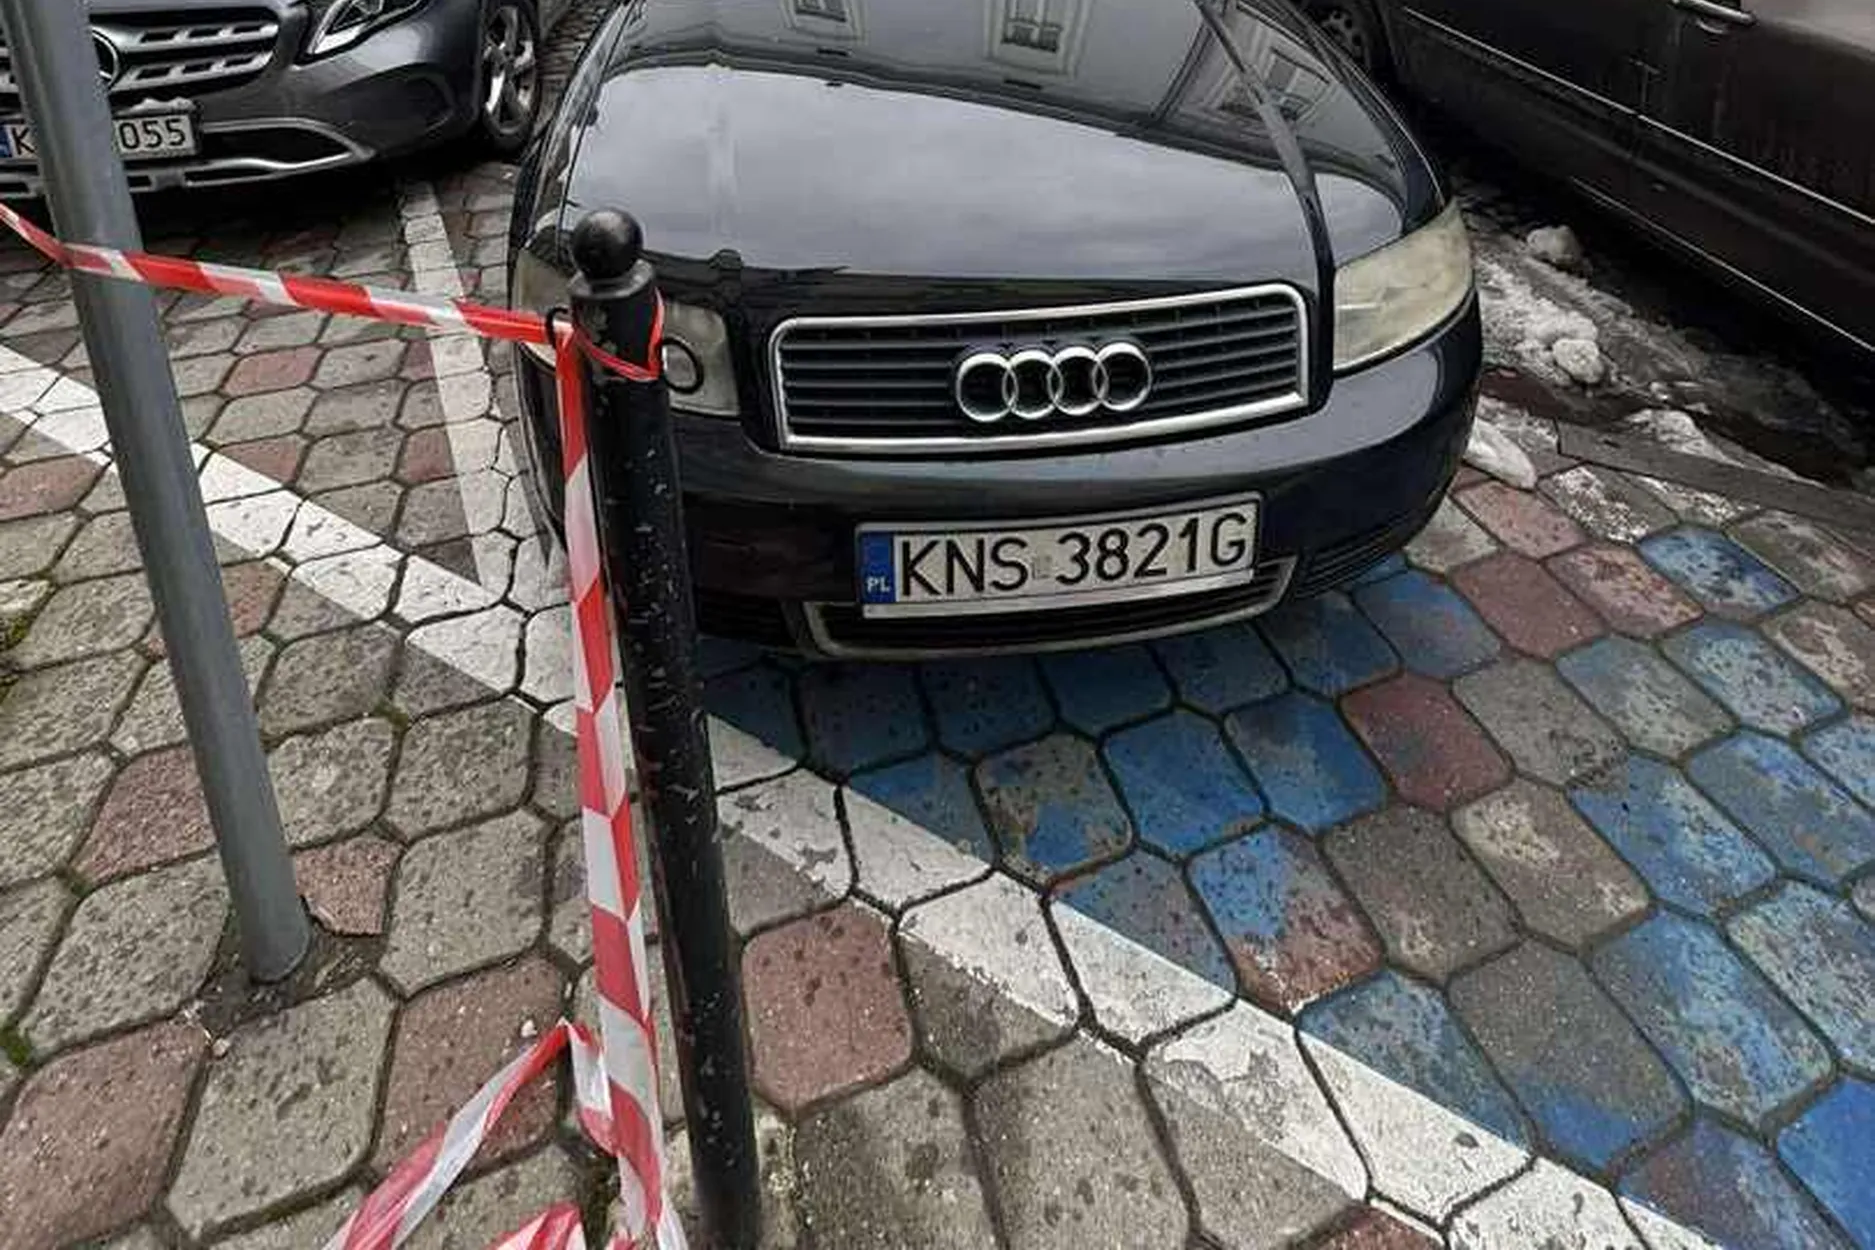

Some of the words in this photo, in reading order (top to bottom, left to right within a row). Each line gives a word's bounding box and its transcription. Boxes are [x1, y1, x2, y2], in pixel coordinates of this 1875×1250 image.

[11, 126, 36, 155] K
[117, 117, 187, 150] 055
[900, 536, 1029, 597] KNS
[1054, 511, 1249, 587] 3821G
[866, 577, 891, 594] PL
